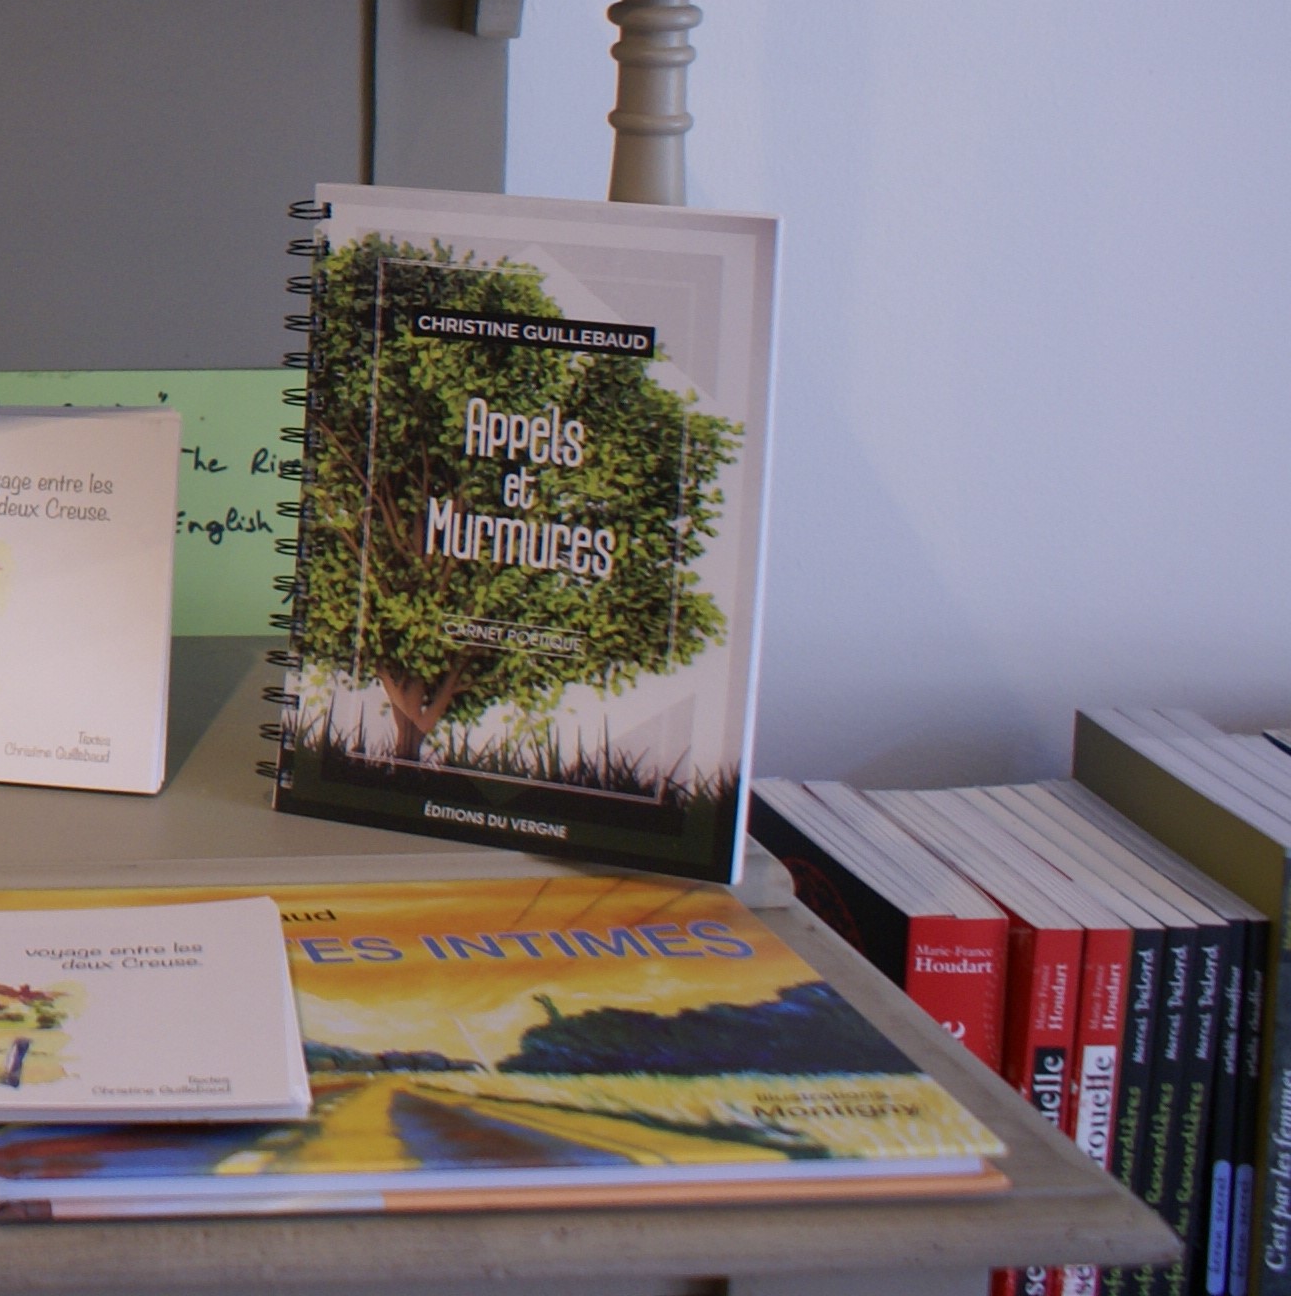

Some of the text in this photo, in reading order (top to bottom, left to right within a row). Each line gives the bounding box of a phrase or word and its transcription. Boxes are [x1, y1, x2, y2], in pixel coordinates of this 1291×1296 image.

[418, 315, 647, 350] CHRISTINE GUILLEBAUD
[466, 397, 585, 467] Appels
[37, 475, 83, 493] entre
[90, 473, 114, 495] les
[503, 466, 535, 510] et
[425, 496, 616, 580] Murmures
[443, 620, 584, 653] CARNET POÉTIQUE
[424, 800, 568, 839] ÉDITIONS DU VERGNE
[287, 920, 755, 964] ES INTIMES
[915, 957, 994, 974] Houdart
[1047, 963, 1068, 1032] Houdart
[1102, 963, 1122, 1032] Houdart
